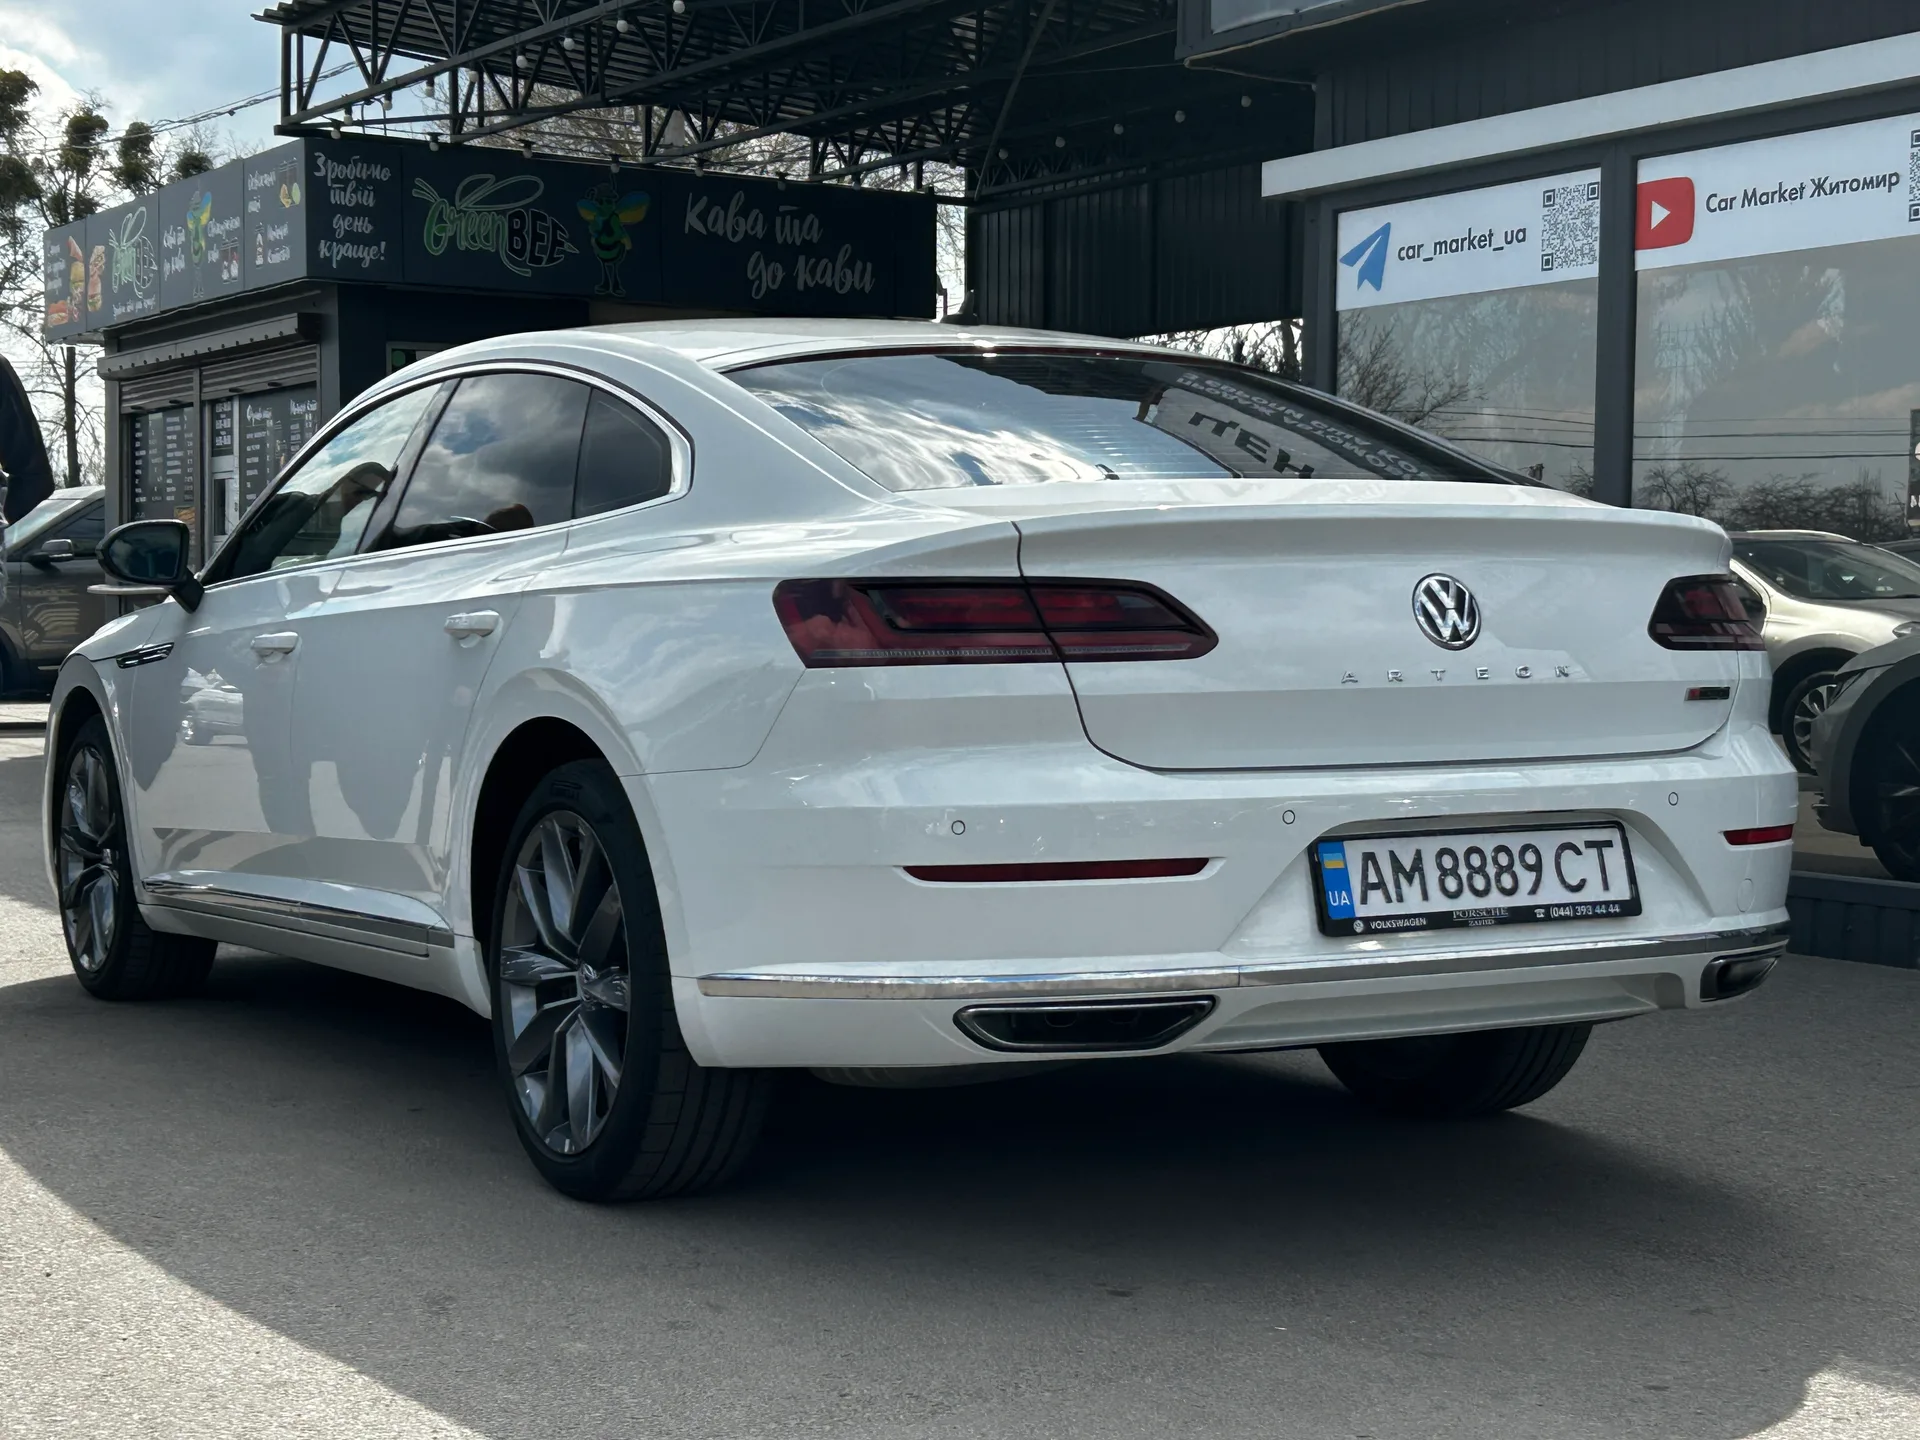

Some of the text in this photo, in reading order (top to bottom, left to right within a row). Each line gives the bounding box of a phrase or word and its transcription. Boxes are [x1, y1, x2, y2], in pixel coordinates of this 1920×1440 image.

[313, 151, 392, 186] Зробимо
[330, 181, 376, 207] твій
[1705, 171, 1901, 213] Car Market Житомир
[332, 213, 375, 239] день
[684, 190, 823, 246] Кава та
[318, 239, 387, 269] краще!
[1397, 226, 1528, 262] car_market_ua
[747, 243, 876, 300] до кави
[1341, 665, 1571, 684] ARTEON
[1329, 890, 1350, 906] UA
[1550, 905, 1573, 918] (044)
[1575, 904, 1593, 916] 393
[1369, 917, 1427, 930] VOLKSWAGEN
[1452, 906, 1509, 919] PORSCHE
